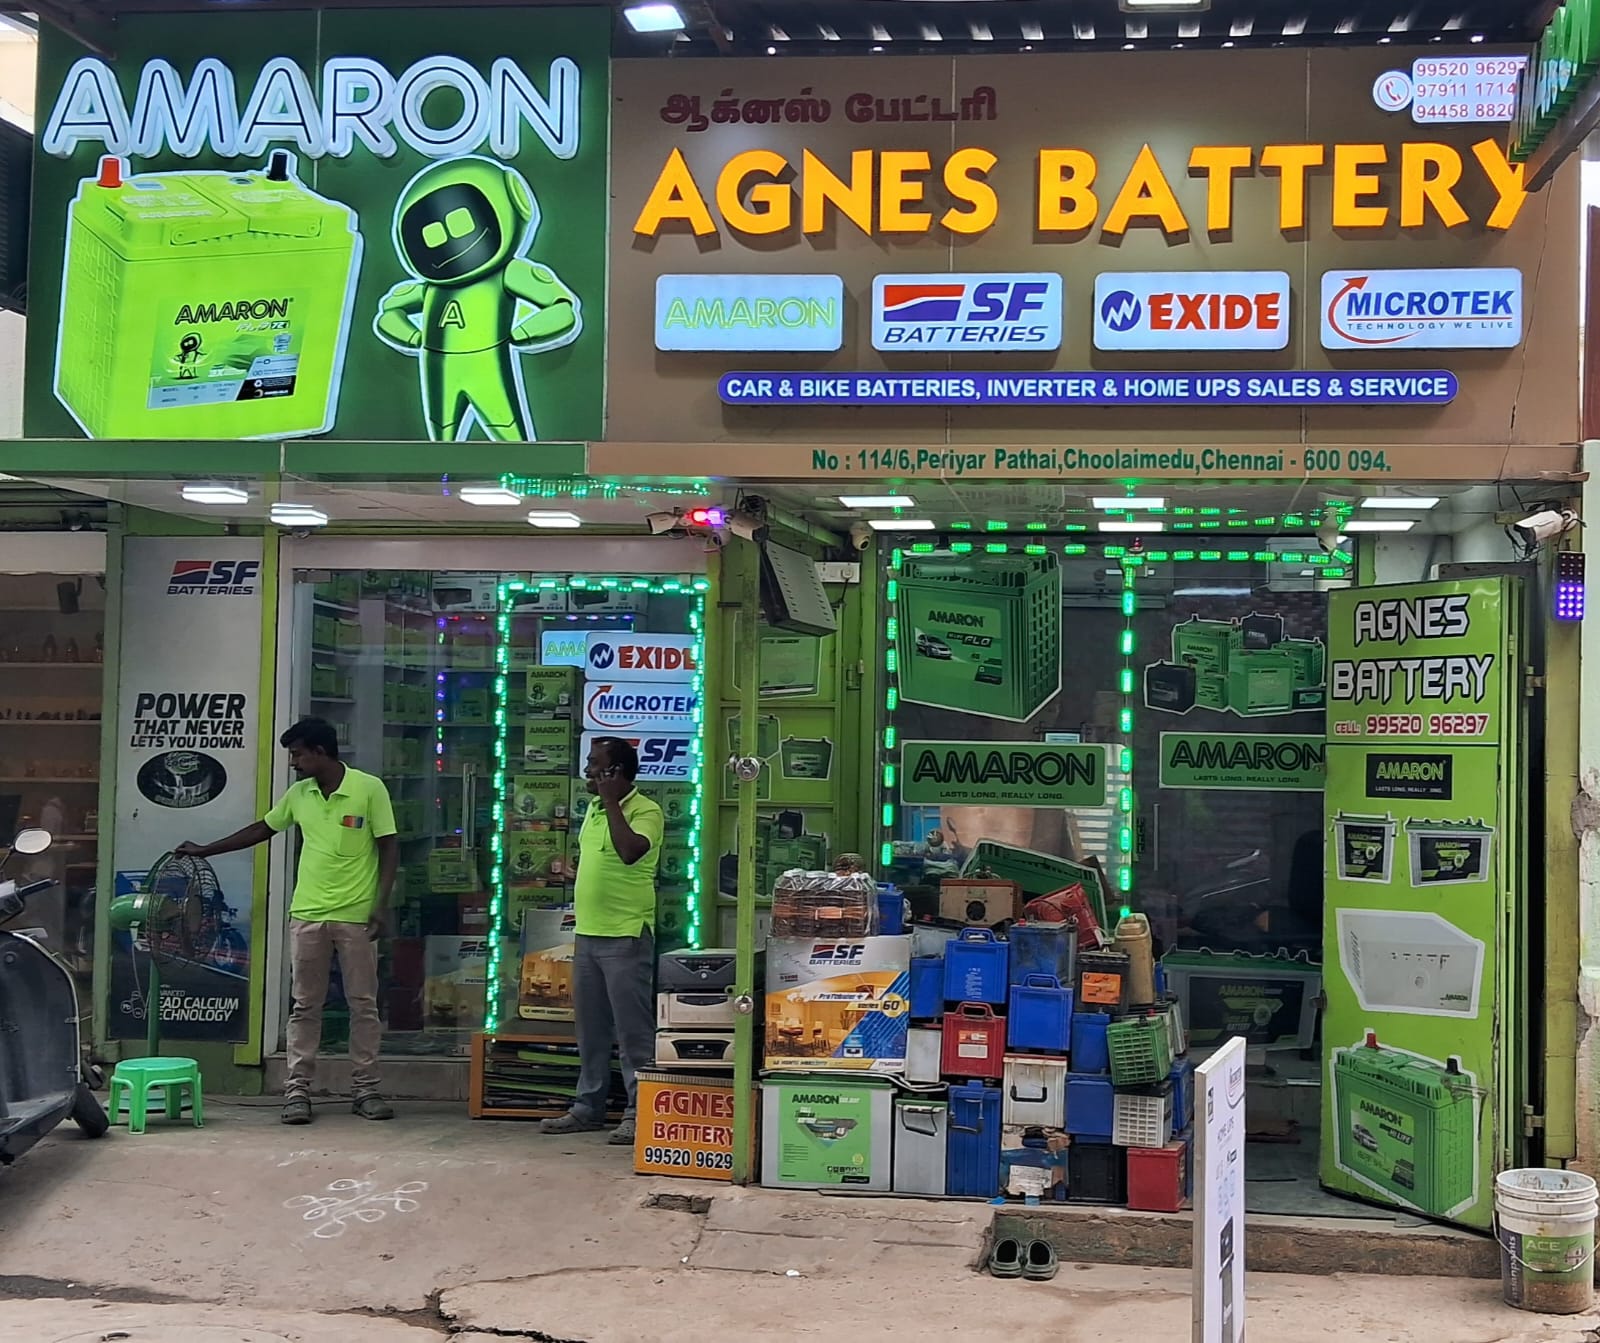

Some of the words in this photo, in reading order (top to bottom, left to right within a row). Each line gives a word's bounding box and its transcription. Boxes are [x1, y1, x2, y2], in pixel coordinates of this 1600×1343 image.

[1416, 62, 1468, 77] 99520
[1416, 83, 1468, 98] 97911
[1475, 82, 1517, 96] 1714
[43, 56, 581, 160] AMARON
[660, 88, 831, 132] ஆக்னஸ்
[845, 86, 998, 122] பேட்டரி
[1416, 104, 1468, 119] 94458
[1475, 103, 1514, 118] 8820
[632, 147, 999, 237] AGNES
[1037, 138, 1528, 234] BATTERY
[175, 299, 288, 325] AMARON
[664, 296, 836, 329] AMARON
[968, 282, 1049, 321] SF
[1148, 293, 1281, 330] EXIDE
[1347, 291, 1515, 316] MICROTEK
[438, 299, 465, 329] A
[1347, 321, 1445, 330] TECHNOLOGY
[1454, 321, 1473, 329] WE
[1481, 321, 1513, 329] LIVE
[883, 326, 1048, 344] BATTERIES
[726, 379, 773, 397] CAR
[778, 379, 794, 397] &
[800, 379, 850, 397] BIKE
[856, 379, 981, 400] BATTERIES,
[988, 379, 1097, 397] INVERTER
[1102, 379, 1118, 397] &
[1124, 379, 1189, 396] HOME
[1196, 378, 1240, 397] UPS
[1247, 378, 1323, 397] SALES
[1328, 378, 1344, 396] &
[1350, 377, 1449, 396] SERVICE
[812, 450, 839, 470] No
[1304, 449, 1341, 471] 600
[1348, 449, 1392, 472] 094.
[208, 561, 260, 584] SF
[167, 586, 254, 595] BATTERIES
[928, 610, 984, 628] AMARON
[1354, 594, 1471, 647] AGNES
[545, 640, 587, 657] AMA
[1332, 654, 1495, 705] BATTERY
[134, 692, 246, 719] POWER
[133, 719, 180, 735] THAT
[185, 719, 245, 736] NEVER
[1334, 720, 1361, 735] CELL:
[1365, 715, 1422, 735] 99520
[1429, 713, 1489, 735] 96297
[130, 735, 165, 748] LETS
[168, 735, 198, 748] YOU
[200, 736, 246, 749] DOWN.
[640, 739, 690, 762] SF
[1170, 740, 1325, 771] AMARON
[638, 765, 690, 776] ERIES
[912, 750, 1095, 786] AMARON
[1376, 761, 1444, 781] AMARON
[834, 945, 865, 959] SF
[1218, 984, 1265, 997] AMARON
[159, 997, 181, 1009] EAD
[184, 997, 239, 1010] CALCIUM
[883, 1000, 900, 1011] 60
[159, 1009, 233, 1022] ECHNOLOGY
[653, 1089, 735, 1119] AGNES
[791, 1094, 840, 1104] AMARON
[1360, 1100, 1403, 1127] AMARON
[653, 1120, 734, 1148] BATTERY
[644, 1146, 691, 1167] 99520
[695, 1150, 733, 1170] 9629
[1525, 1239, 1561, 1251] ACE
